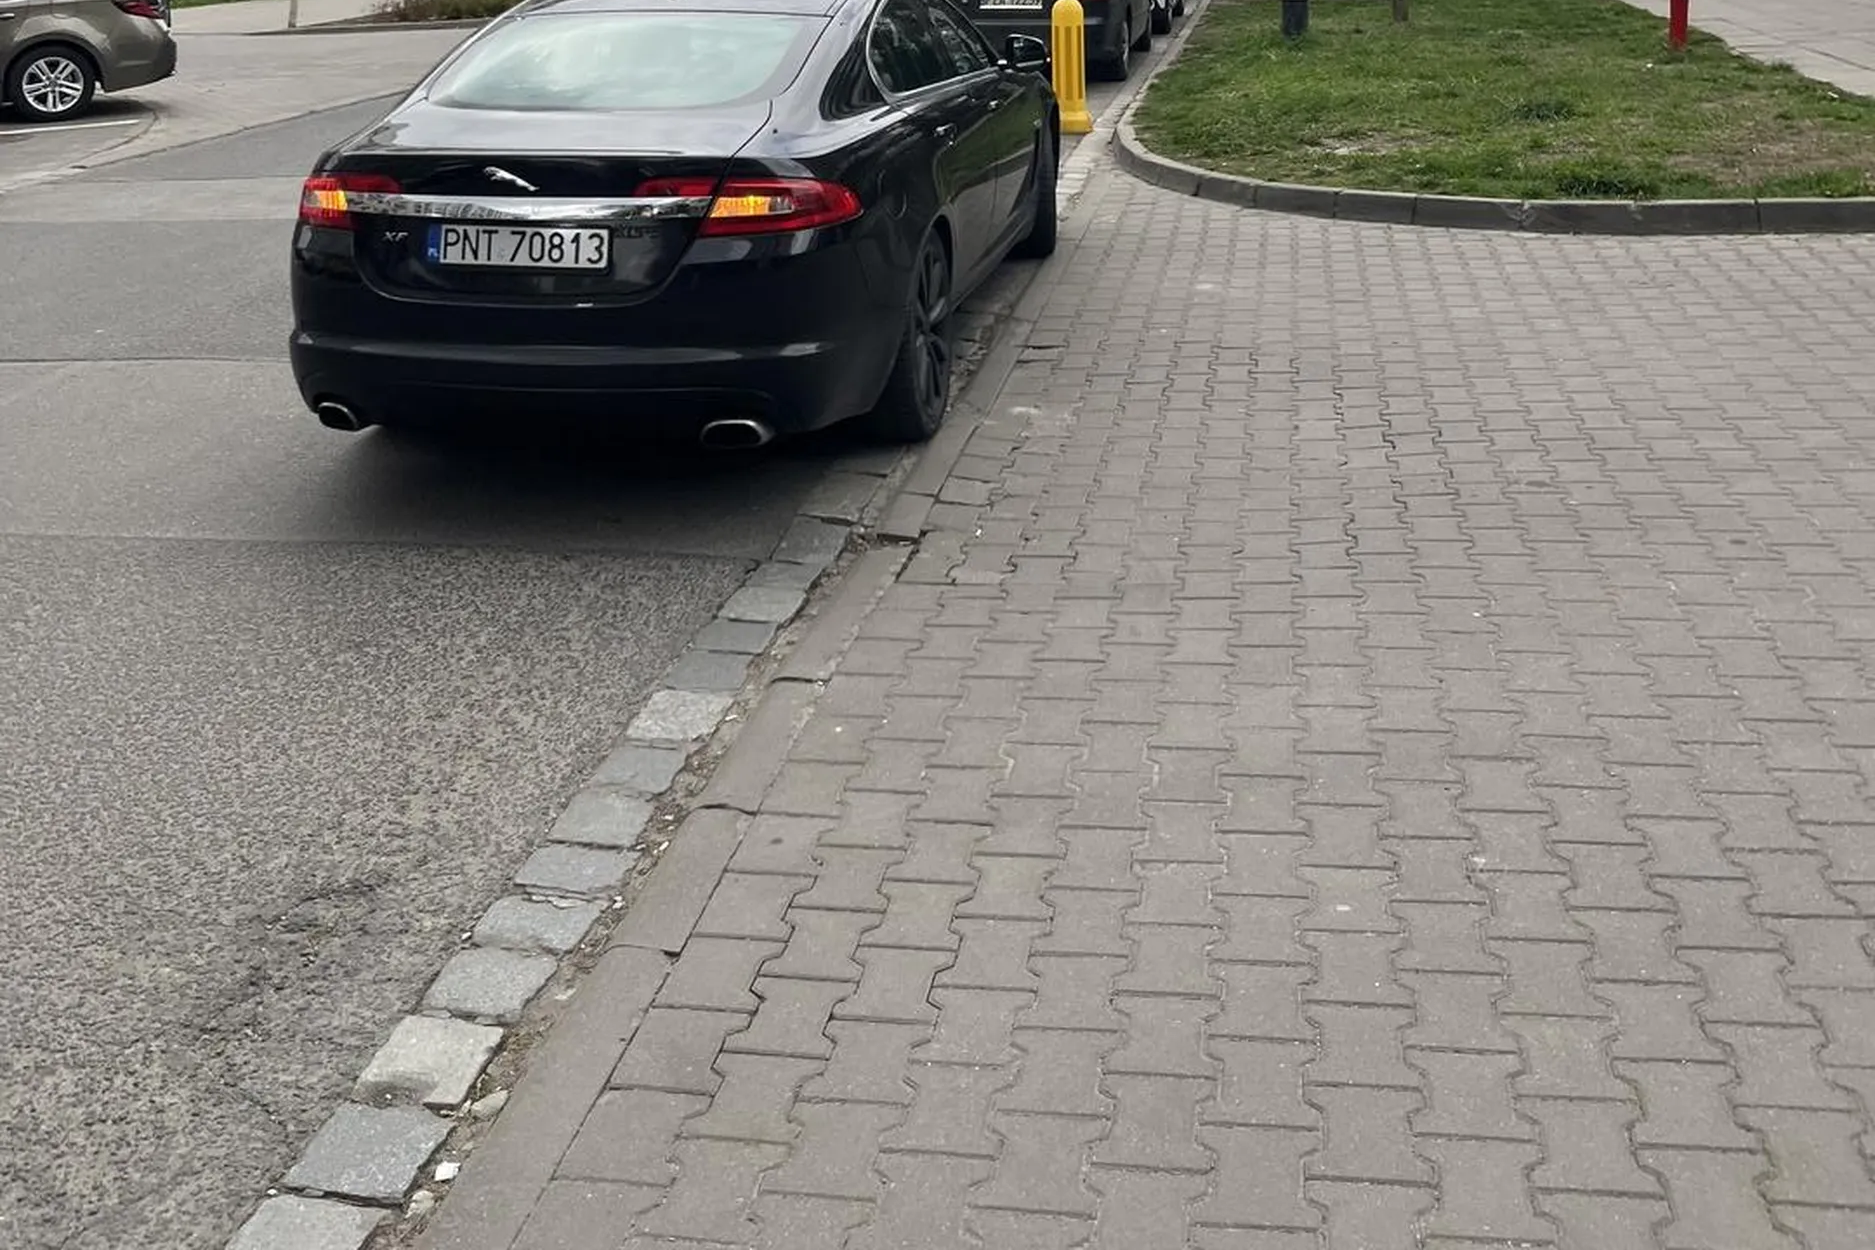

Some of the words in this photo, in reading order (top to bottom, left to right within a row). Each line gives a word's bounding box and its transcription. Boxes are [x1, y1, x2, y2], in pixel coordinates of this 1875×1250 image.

[381, 230, 409, 243] XF
[442, 228, 500, 262] PNT
[509, 230, 605, 265] 70813
